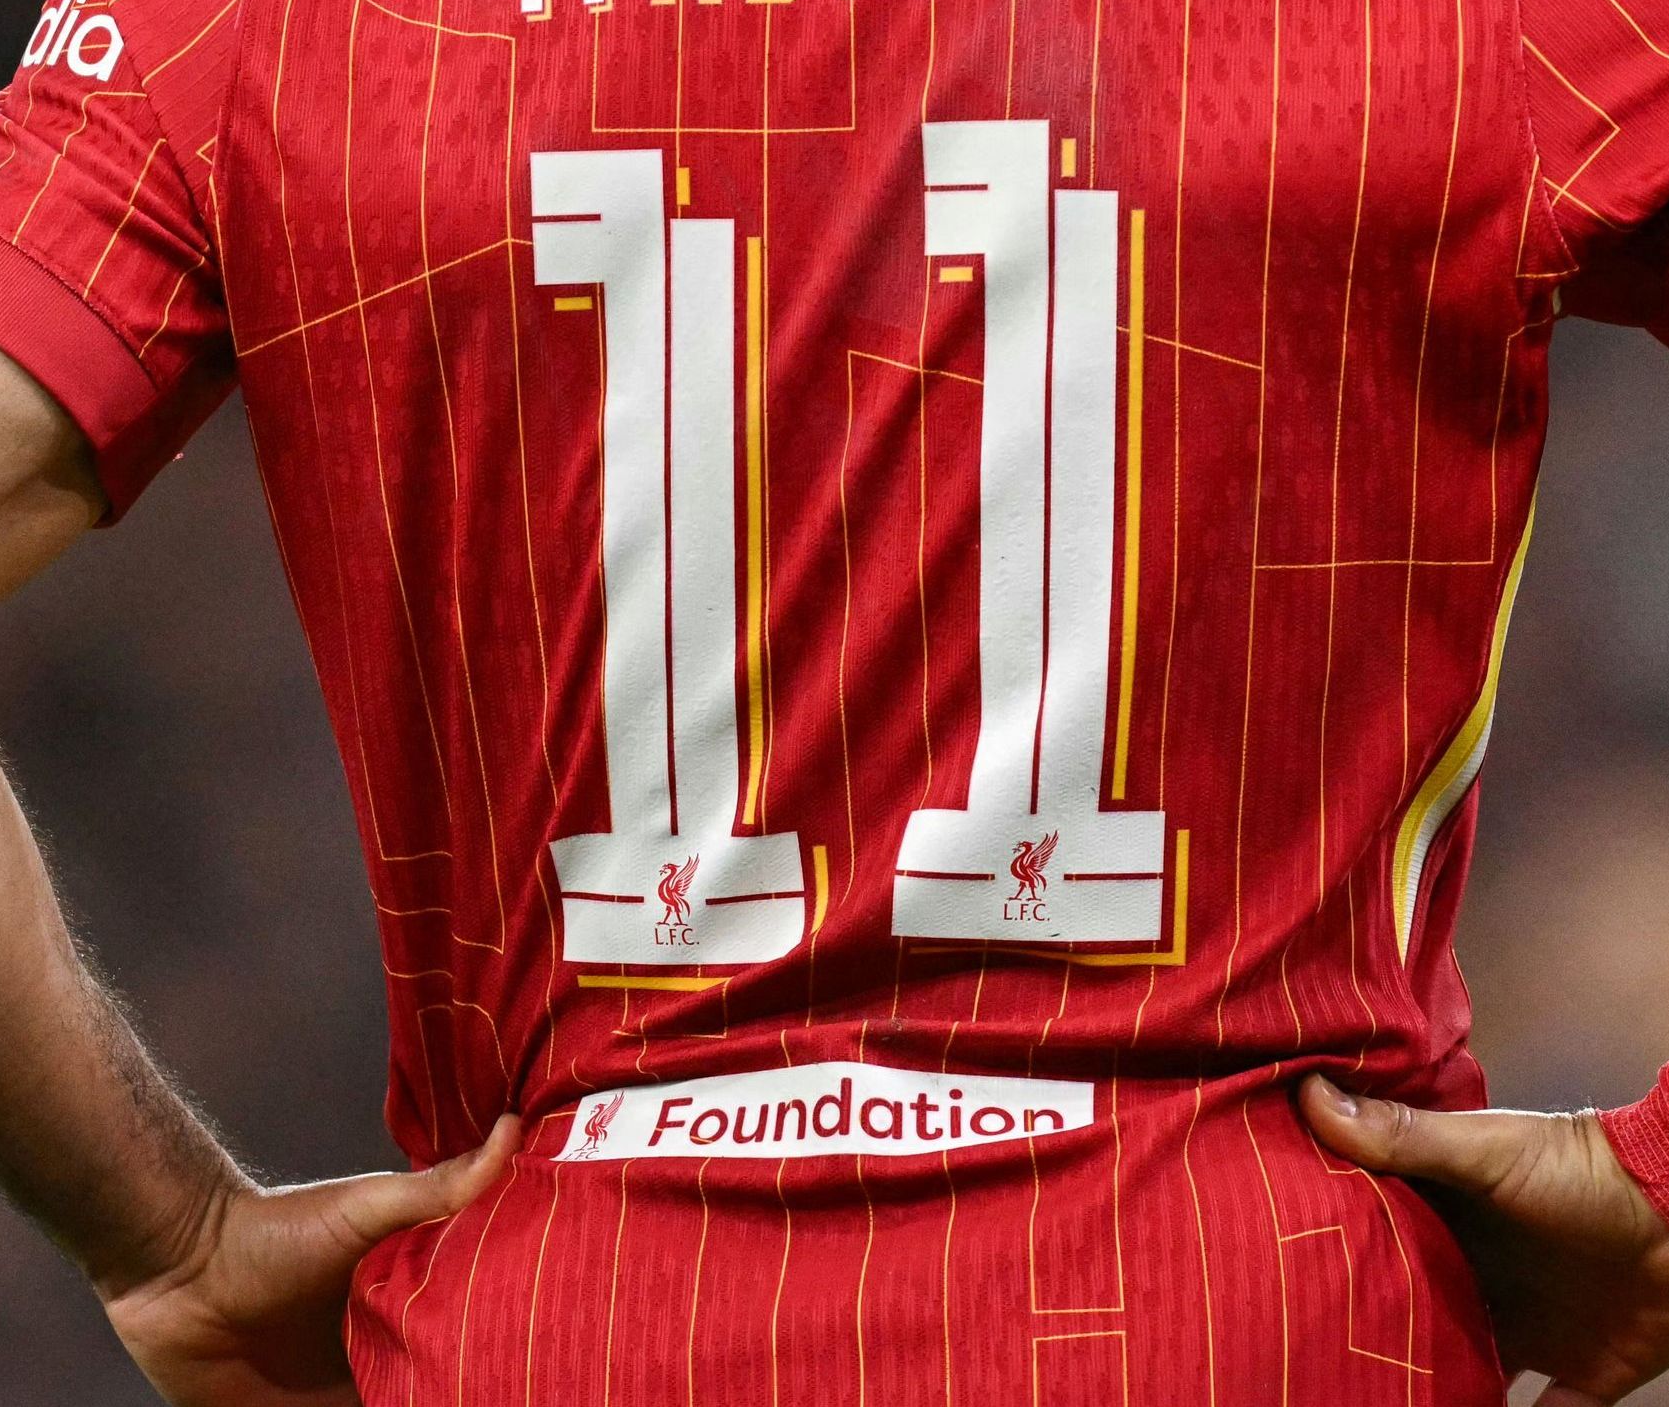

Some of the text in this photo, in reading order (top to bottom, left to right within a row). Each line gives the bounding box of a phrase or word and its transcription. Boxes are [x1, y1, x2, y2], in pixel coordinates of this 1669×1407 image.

[530, 119, 1192, 989] 11
[1003, 902, 1051, 921] L.F.C.
[654, 927, 700, 946] L.F.C.
[647, 1077, 1065, 1147] Foundation
